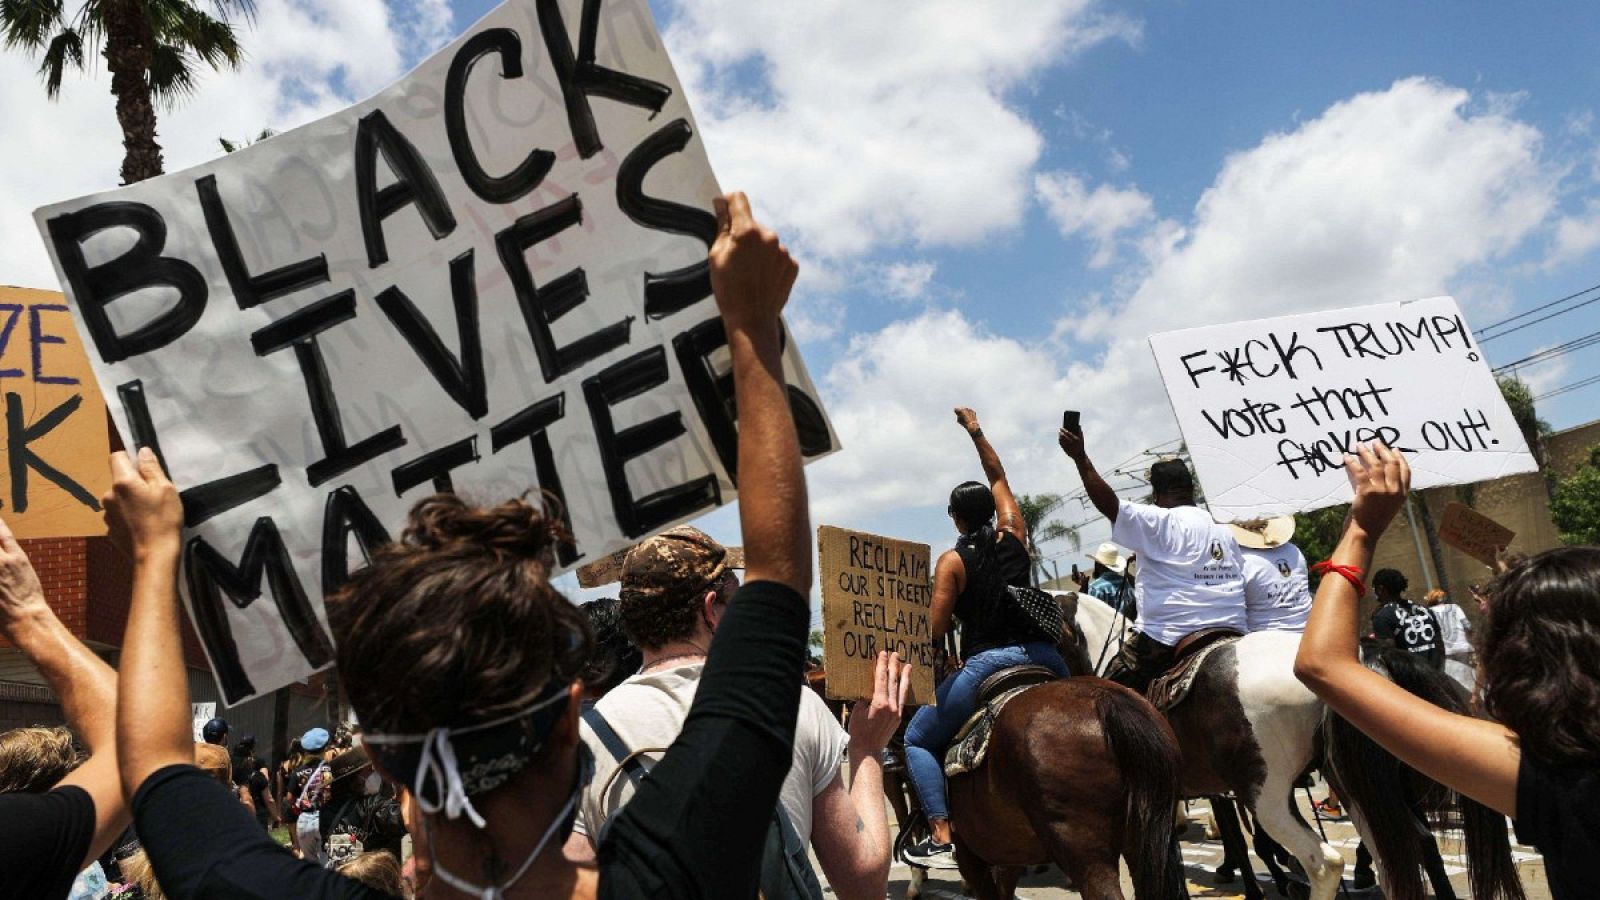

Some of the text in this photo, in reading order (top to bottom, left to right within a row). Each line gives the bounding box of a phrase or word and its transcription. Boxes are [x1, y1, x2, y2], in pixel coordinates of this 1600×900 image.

[47, 0, 671, 364] BLACK
[117, 118, 719, 529] LIVES
[1317, 314, 1480, 363] TRUMP!
[1202, 378, 1393, 440] vote that
[0, 391, 103, 513] K
[849, 535, 929, 582] RECLAIM
[838, 571, 933, 609] OUR STREETS
[852, 599, 930, 640] RECLAIM
[843, 631, 933, 669] OUR HOMES
